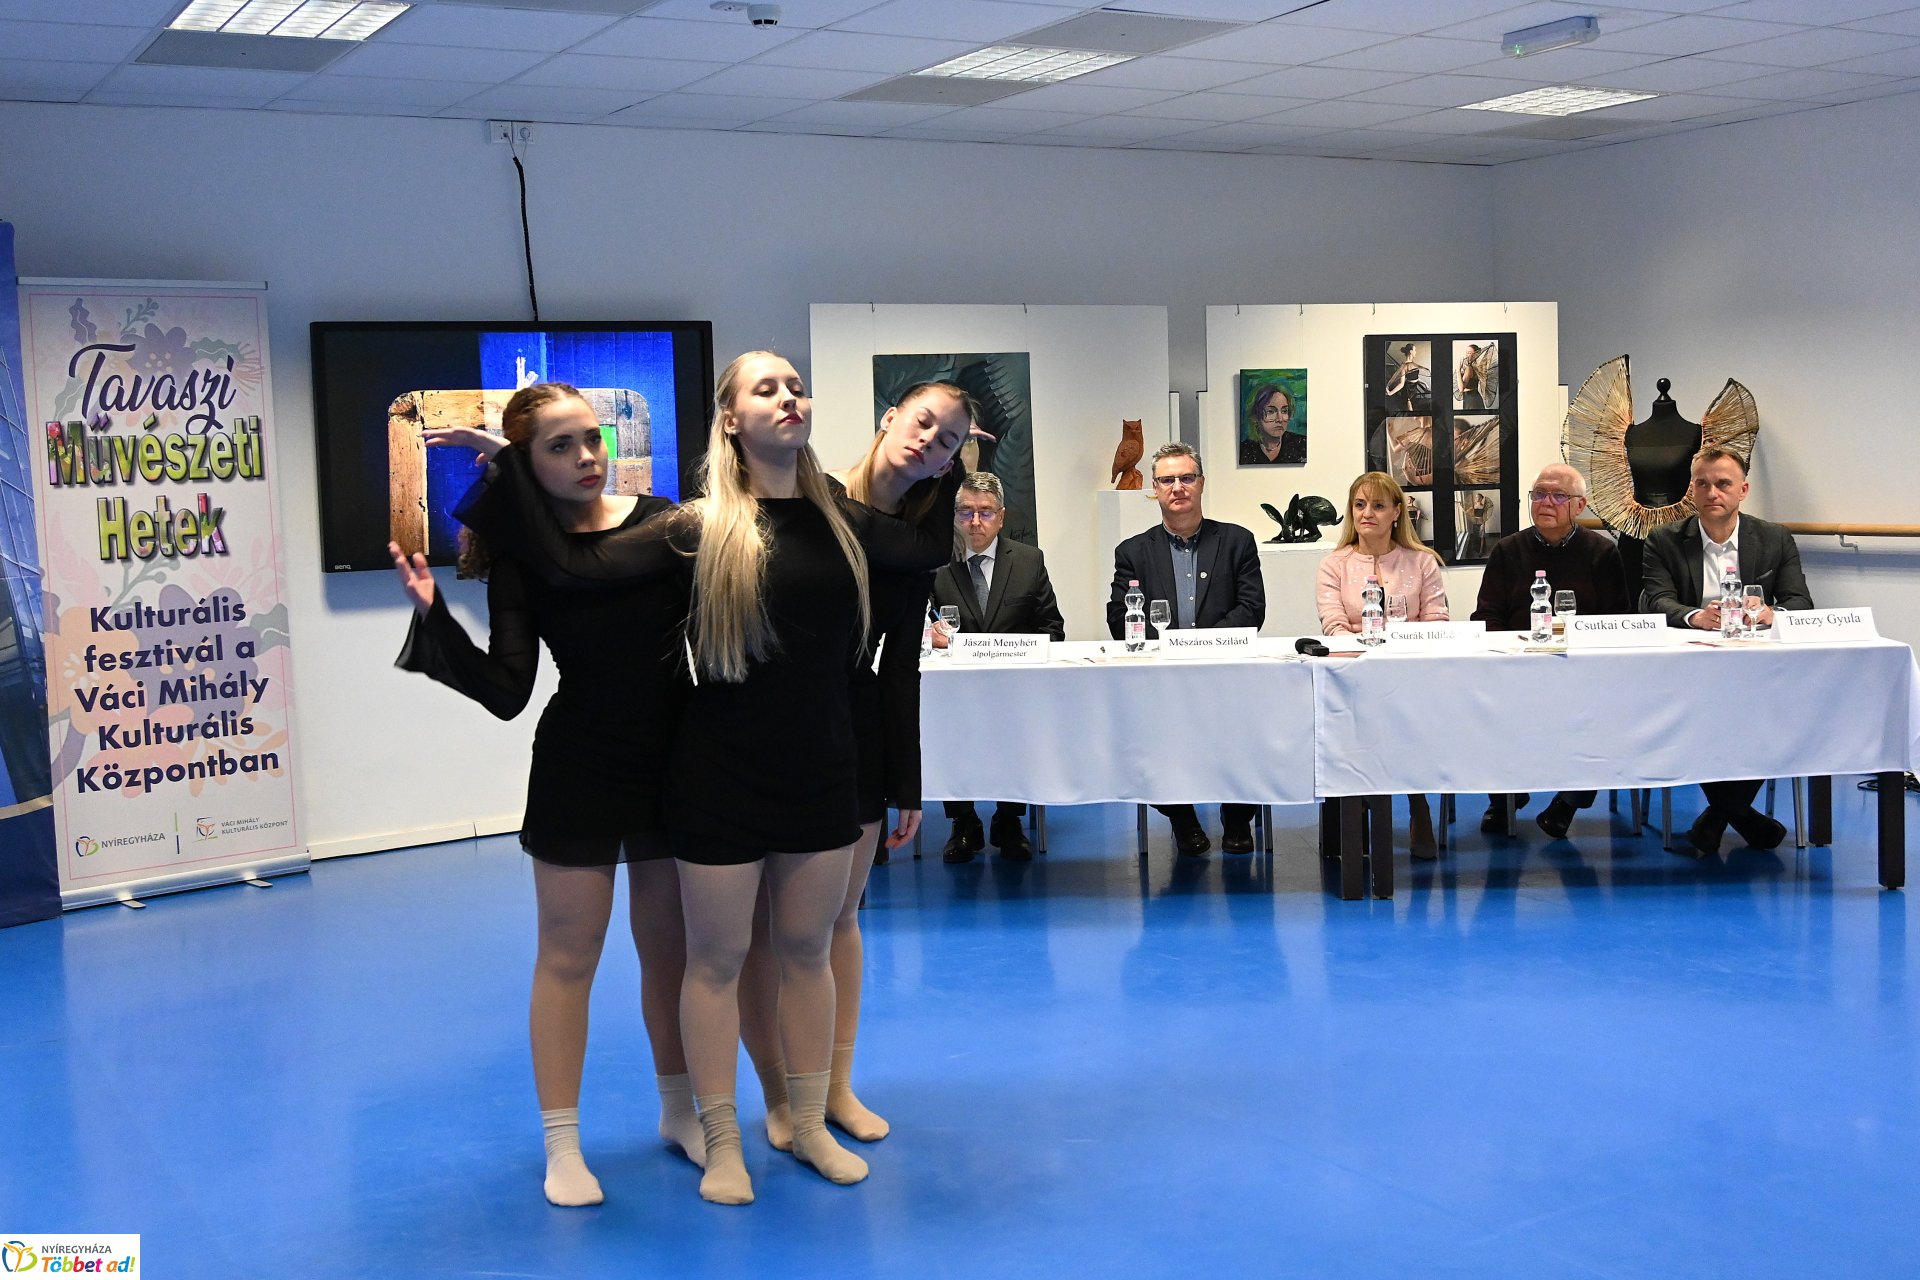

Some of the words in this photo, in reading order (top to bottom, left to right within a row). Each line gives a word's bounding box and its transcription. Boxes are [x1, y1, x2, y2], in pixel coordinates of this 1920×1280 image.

[69, 343, 237, 436] Tavaszi
[45, 412, 265, 486] Művészeti
[97, 493, 227, 561] Hetek
[91, 596, 247, 632] Kulturális
[1786, 614, 1824, 628] Tarczy
[1826, 612, 1861, 626] Gyula
[1574, 618, 1618, 630] Csutkai
[1621, 618, 1656, 630] Csaba
[963, 637, 991, 649] Jászai
[993, 636, 1037, 650] Menyhért
[1169, 636, 1213, 647] Mészáros
[1215, 635, 1249, 646] Szilárd
[1390, 631, 1424, 640] Csurák
[84, 635, 224, 673] fesztivál
[236, 640, 256, 659] a
[972, 649, 1027, 659] alpolgármester
[75, 681, 146, 713] Váci
[159, 671, 270, 705] Mihály
[98, 711, 254, 751] Kulturális
[77, 749, 279, 793] Központban
[222, 824, 259, 835] KULTURÁLIS
[236, 817, 260, 825] MIHÁLY
[101, 831, 166, 849] NYÍREGYHÁZA
